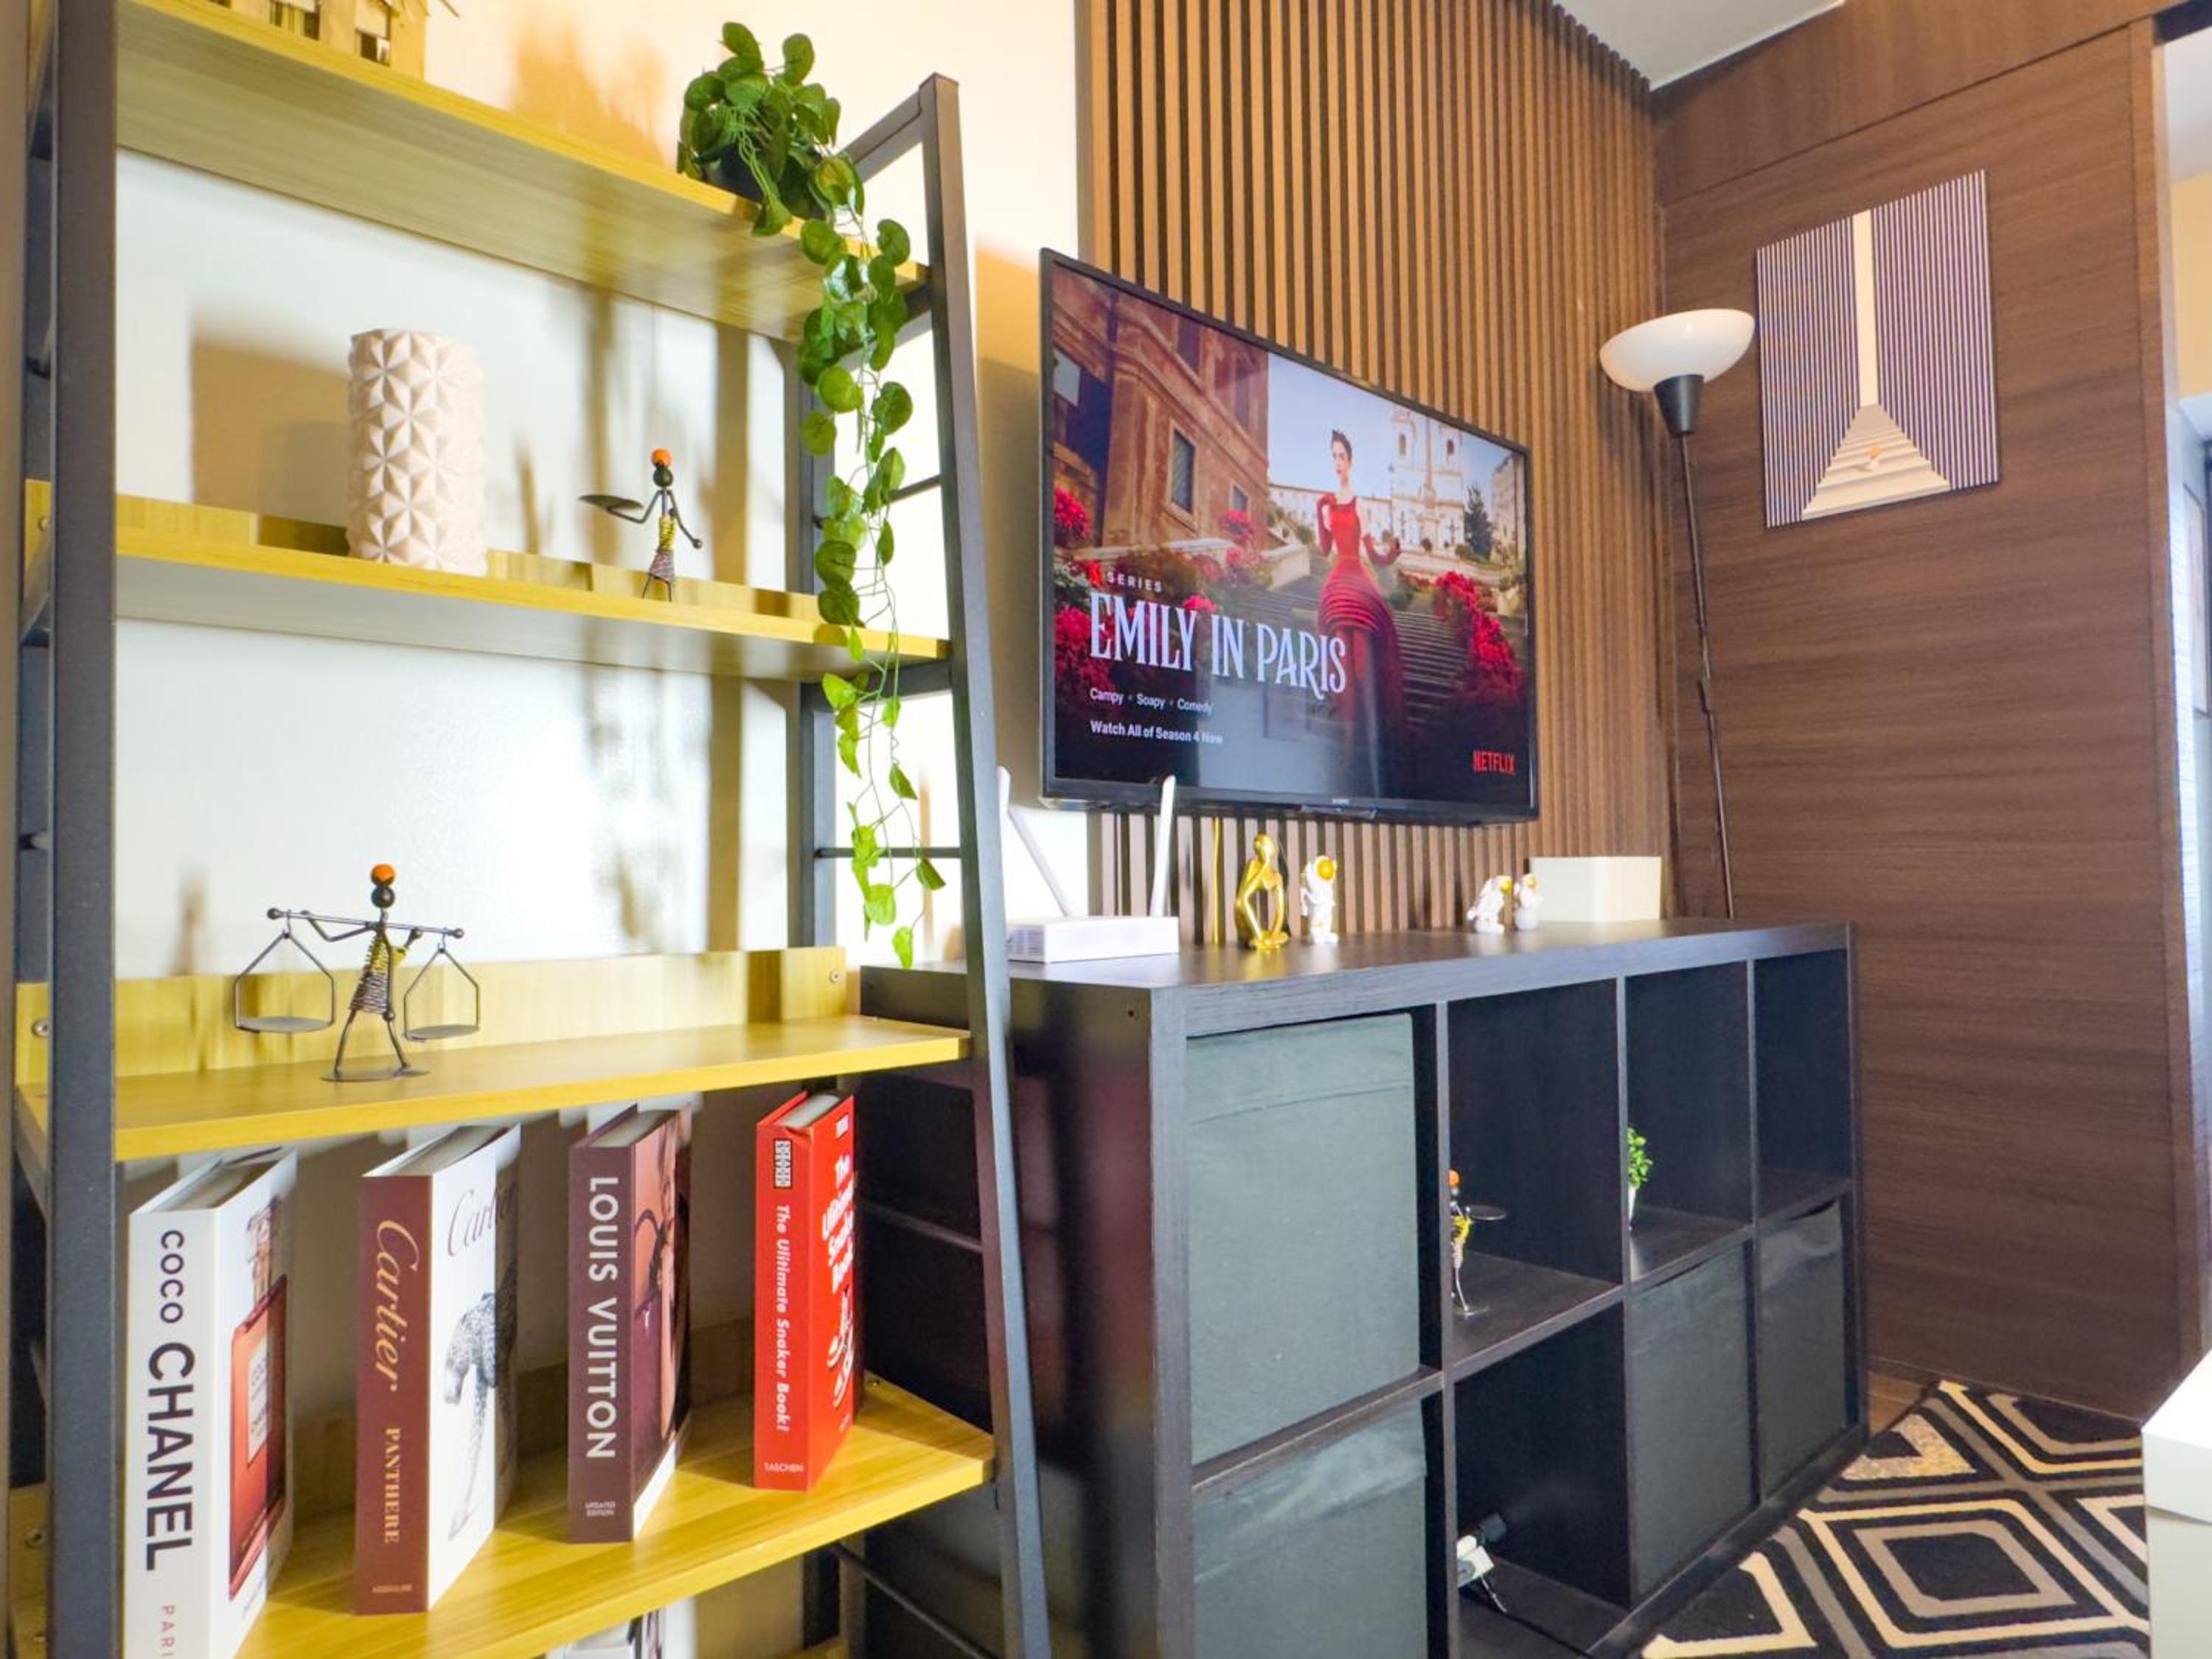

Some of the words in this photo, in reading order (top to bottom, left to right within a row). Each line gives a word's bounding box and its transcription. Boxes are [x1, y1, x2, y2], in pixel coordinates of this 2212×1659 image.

[1107, 571, 1162, 593] SERIES
[1090, 590, 1198, 672] EMILY
[1211, 613, 1245, 679] IN
[1256, 622, 1346, 700] PARIS
[1089, 686, 1124, 704] Campy
[1136, 692, 1166, 710] Soapy
[1177, 698, 1213, 716] Comedy
[1090, 720, 1126, 736] Watch
[1127, 724, 1141, 737] All
[1143, 726, 1154, 738] of
[1155, 726, 1192, 742] Season
[1192, 732, 1200, 742] 4
[1201, 733, 1223, 744] Now
[1472, 750, 1515, 775] NETFLIX
[588, 1177, 619, 1282] LOUIS
[776, 1204, 791, 1234] The
[160, 1230, 184, 1324] COCO
[376, 1220, 420, 1391] Cartier
[586, 1297, 618, 1459] VUITTON
[776, 1382, 791, 1433] Book!
[146, 1342, 195, 1571] CHANEL
[764, 1462, 803, 1472] TASCHEN
[384, 1427, 401, 1543] PANTHERE
[161, 1604, 176, 1657] PARI
